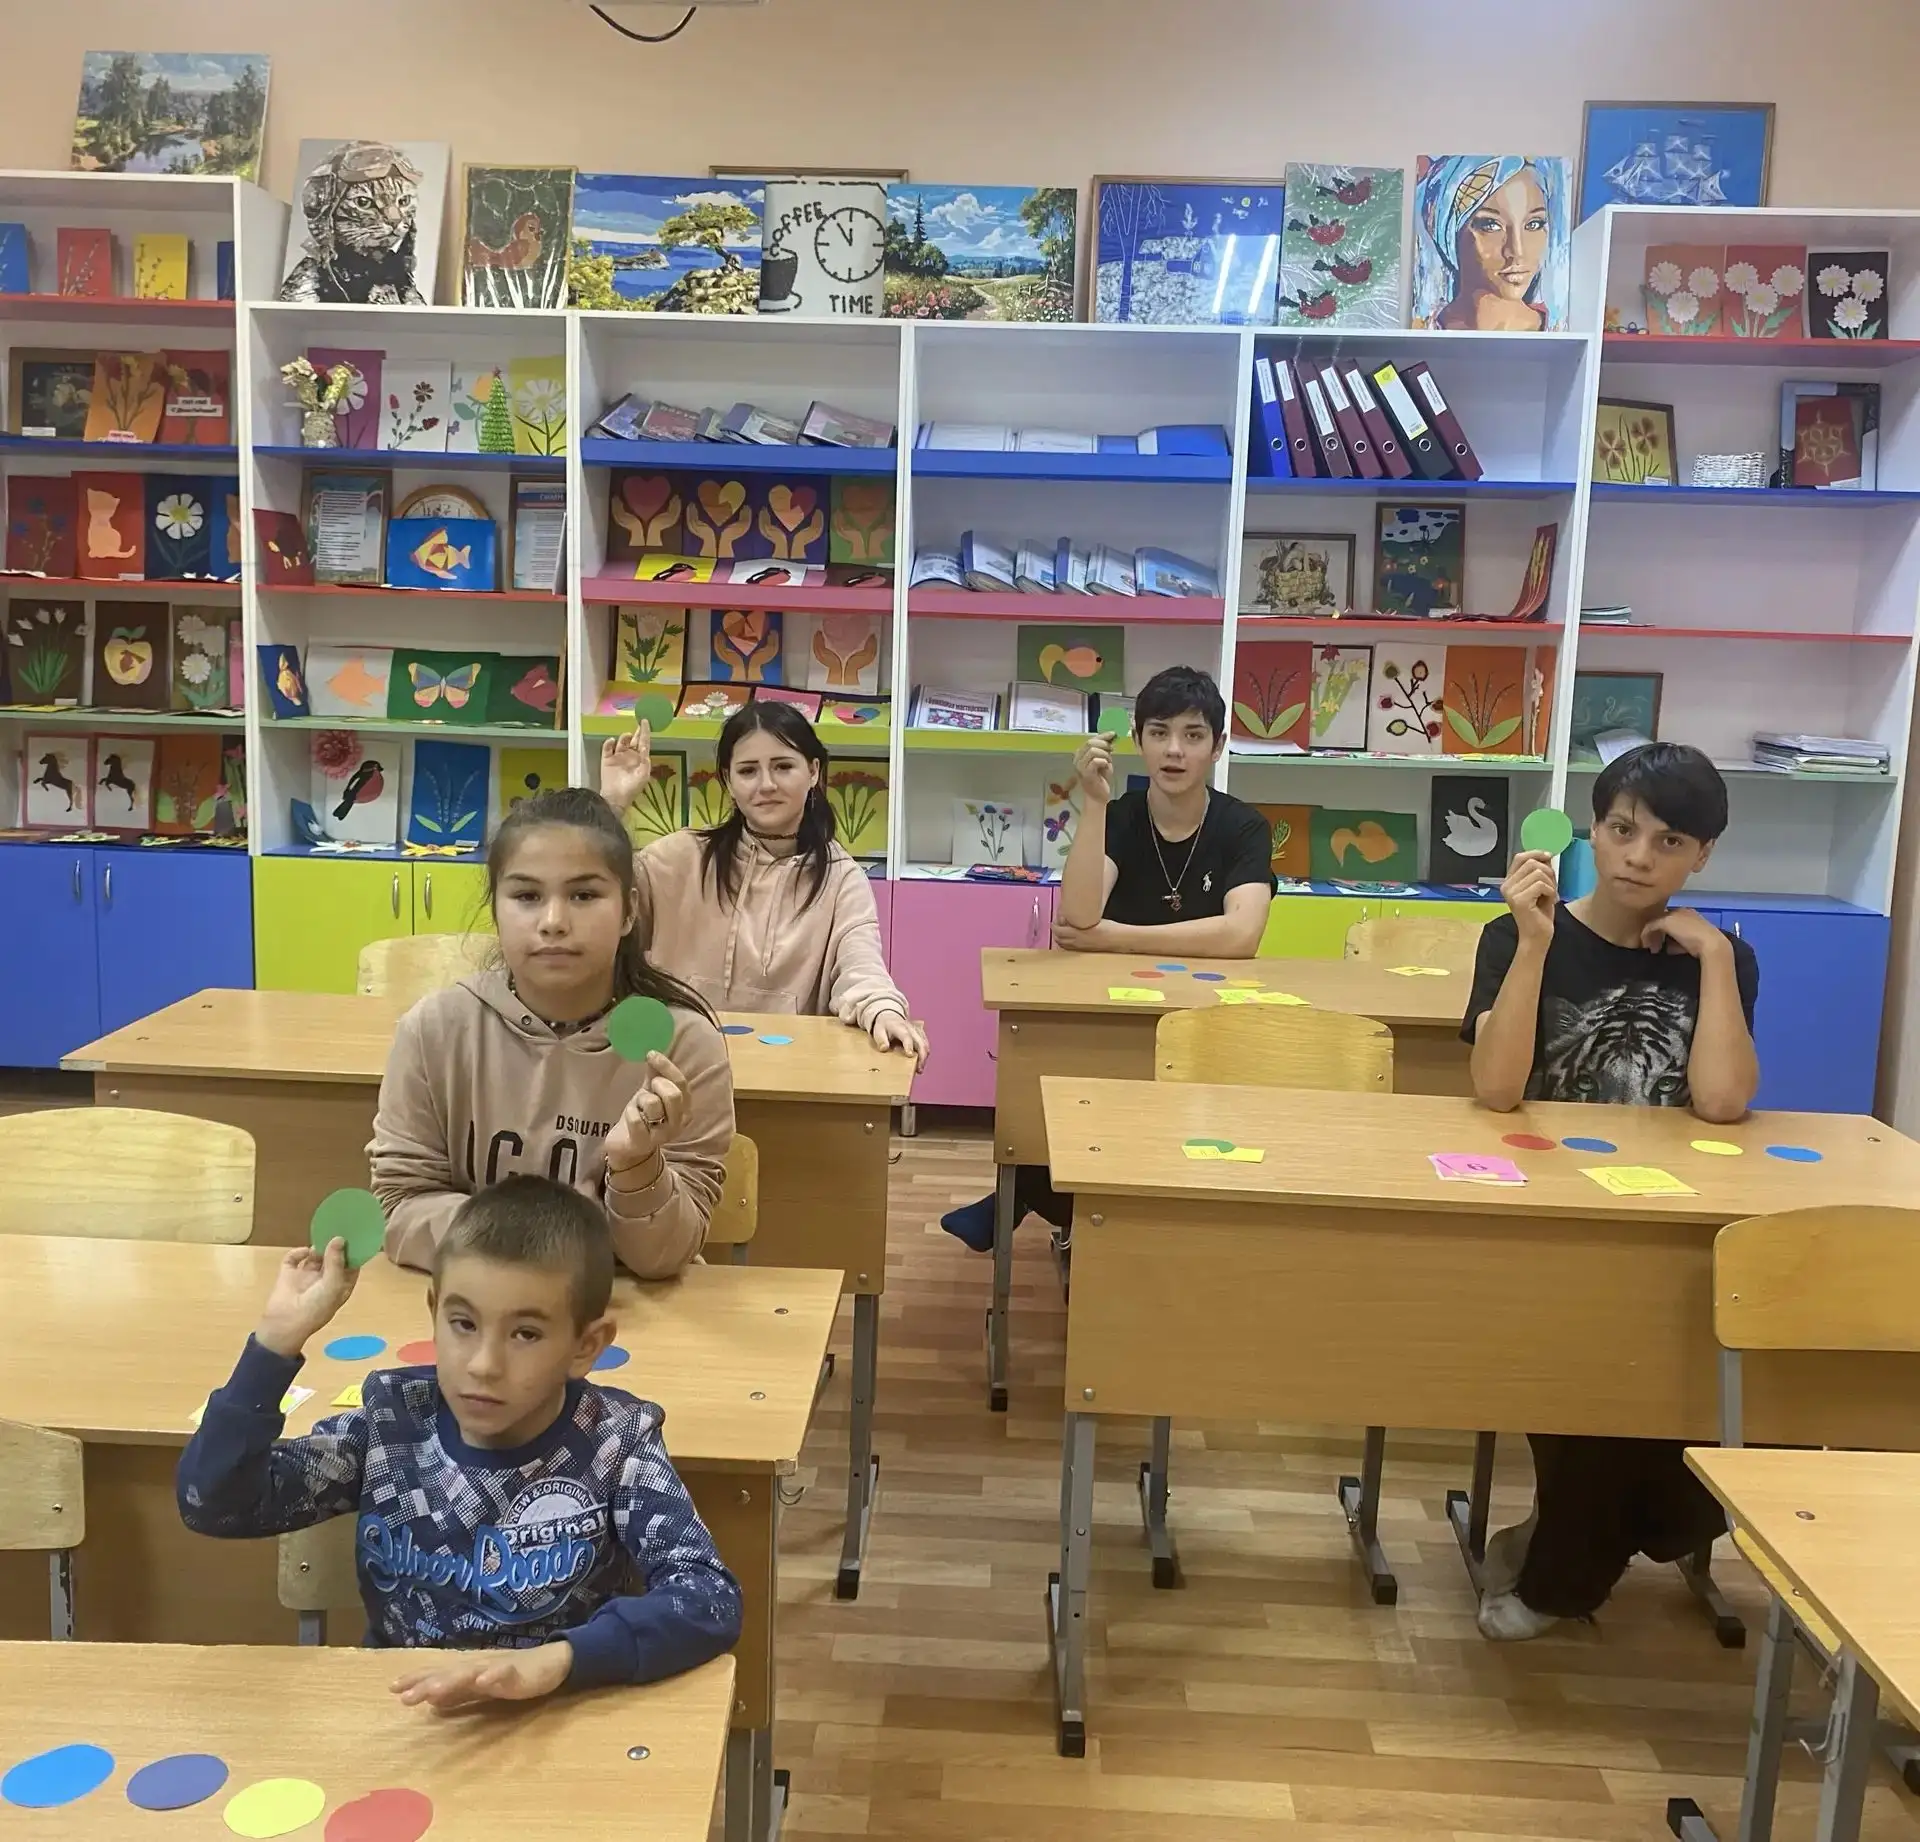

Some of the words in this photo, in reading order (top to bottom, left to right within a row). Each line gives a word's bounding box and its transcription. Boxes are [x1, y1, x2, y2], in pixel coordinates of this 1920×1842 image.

[829, 294, 873, 315] TIME
[556, 1114, 617, 1138] DSQUAR
[508, 1494, 531, 1524] NEW
[543, 1481, 592, 1509] ORIGINAL
